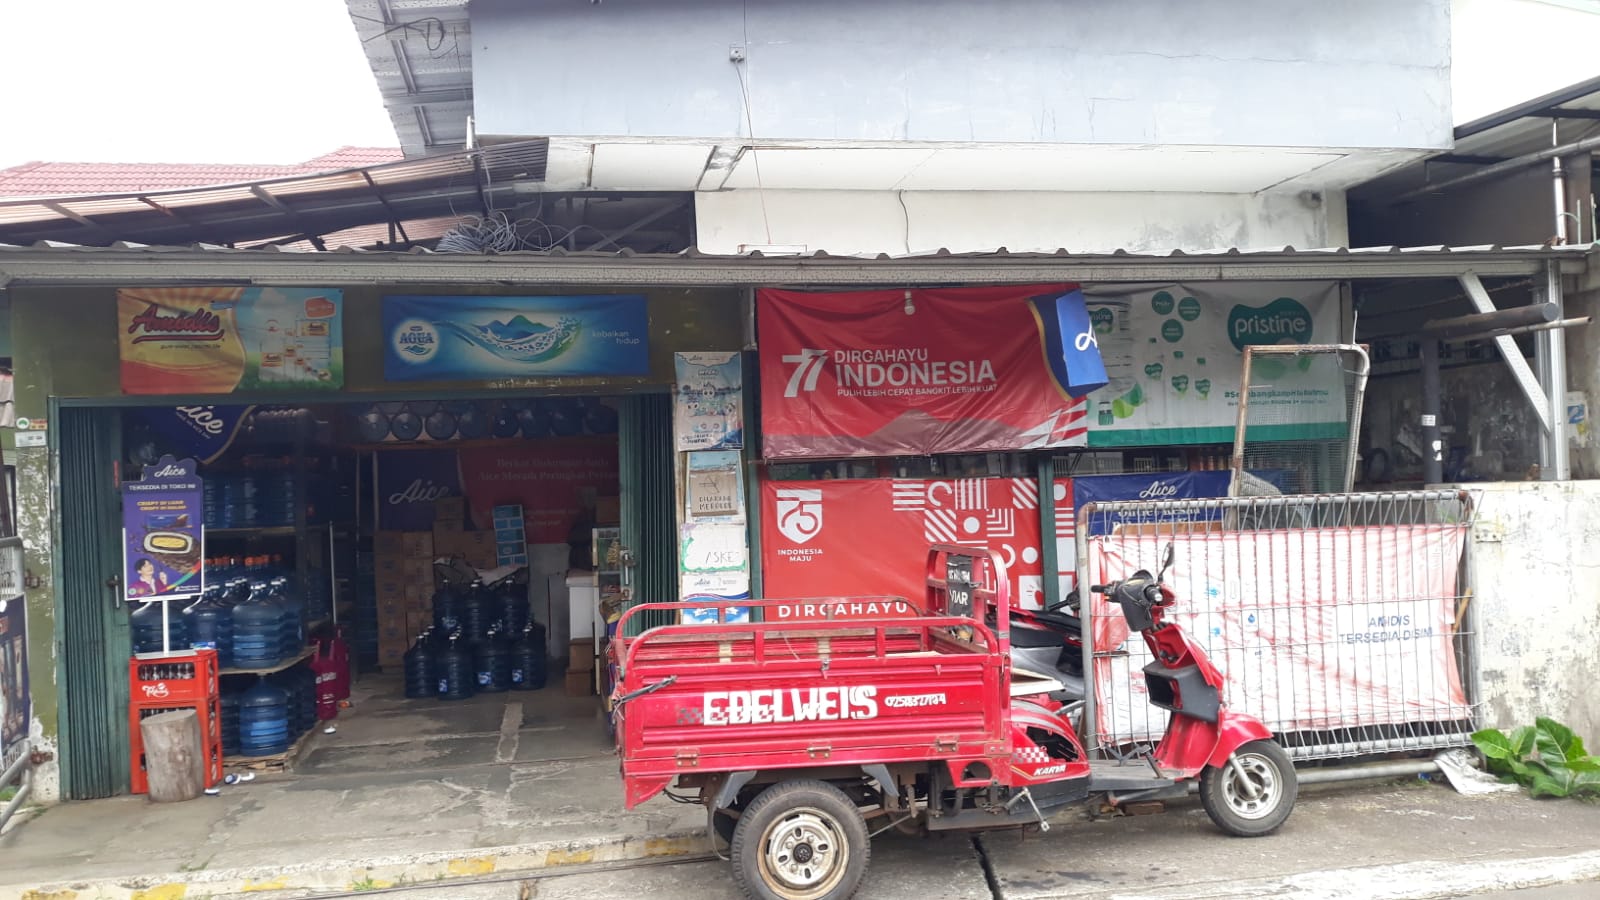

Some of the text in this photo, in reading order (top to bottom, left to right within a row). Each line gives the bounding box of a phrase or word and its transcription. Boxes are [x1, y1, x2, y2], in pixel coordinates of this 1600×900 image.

[1235, 315, 1306, 339] pristine
[400, 332, 434, 345] AQUA
[616, 335, 640, 345] hidup
[834, 348, 928, 364] DIRGAHAYU
[836, 359, 996, 387] INDONESIA
[837, 389, 862, 397] PULIH
[863, 389, 886, 397] LEBIH
[887, 388, 914, 396] CEPAT
[915, 386, 951, 395] BANGKIT
[154, 464, 186, 478] Aice
[389, 478, 449, 504] Aice
[1139, 481, 1178, 499] Aice
[777, 548, 823, 556] INDONESIA
[1340, 630, 1399, 645] TERSEDIA
[703, 685, 877, 726] EDELWEIS
[1034, 764, 1067, 777] KARYA
